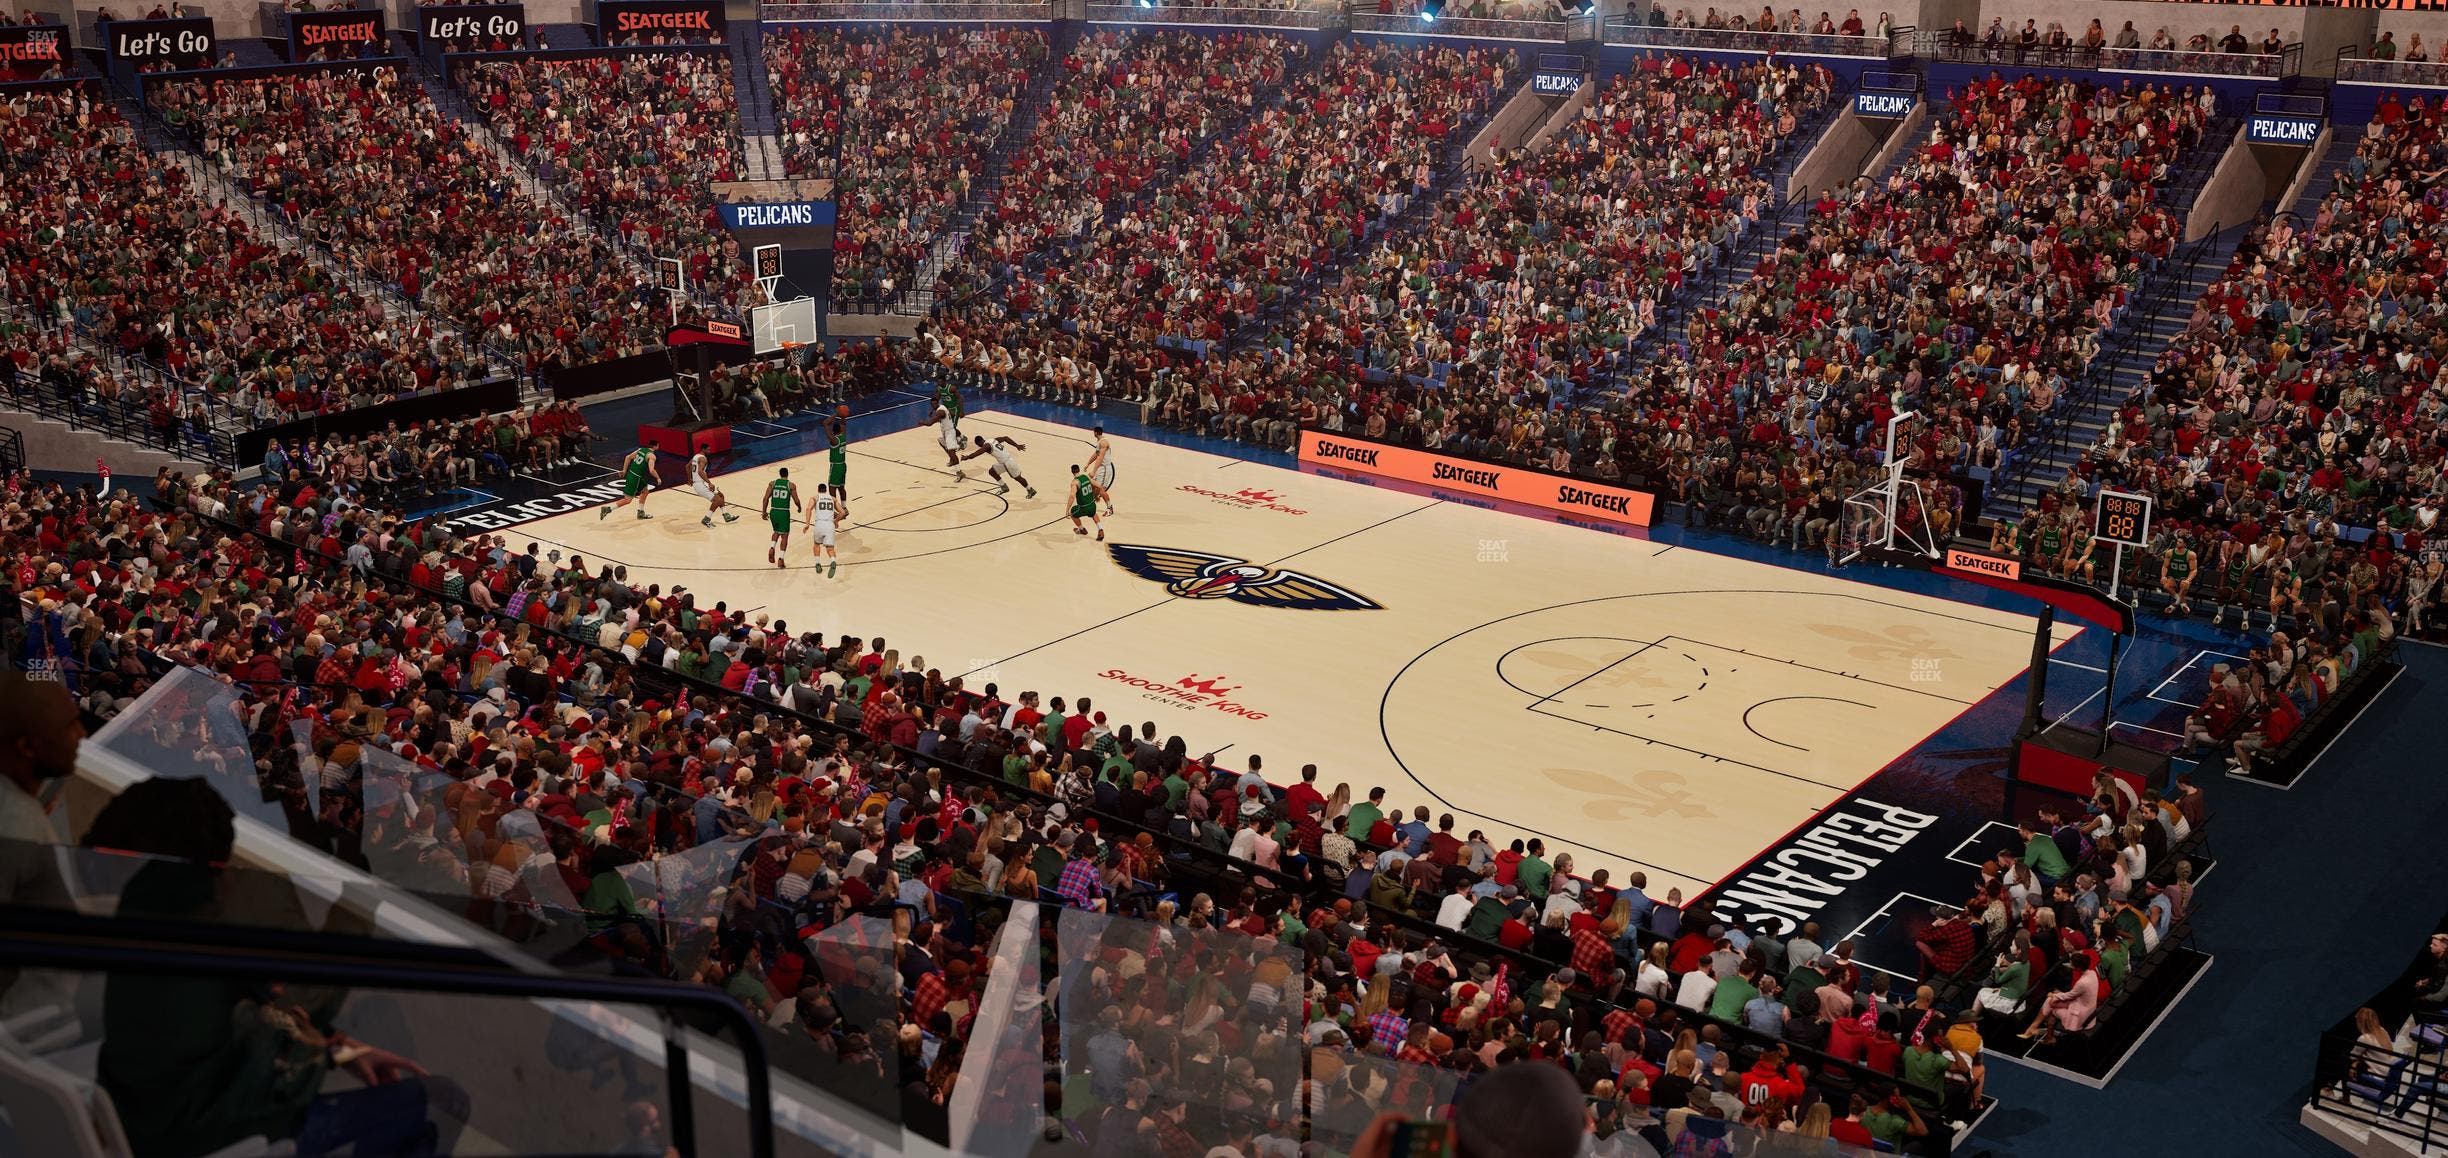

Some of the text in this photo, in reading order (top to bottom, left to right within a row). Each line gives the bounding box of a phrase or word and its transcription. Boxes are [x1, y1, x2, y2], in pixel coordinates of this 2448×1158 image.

[430, 15, 519, 38] Let's Go
[618, 10, 711, 31] SEATGEEK
[119, 30, 209, 57] Let's Go
[302, 21, 378, 46] SEATGEEK
[0, 38, 62, 60] TGEEK
[1536, 75, 1579, 91] PELICANS
[1859, 95, 1911, 114] PELICANS
[2253, 119, 2317, 140] PELICANS
[737, 204, 812, 226] PELICANS
[711, 323, 738, 337] SEATGEEK
[1316, 440, 1379, 467] SEATGEEK
[1432, 462, 1500, 490] SEATGEEK
[1558, 485, 1631, 515] SEATGEEK
[2107, 498, 2140, 515] 88 88
[2108, 514, 2135, 539] 88
[1955, 554, 2011, 575] SEATGEEK
[1097, 669, 1210, 703] SMOOTHIE
[1142, 693, 1196, 711] CENTER
[1711, 797, 1940, 936] PELICANS
[1749, 1082, 1769, 1105] 00
